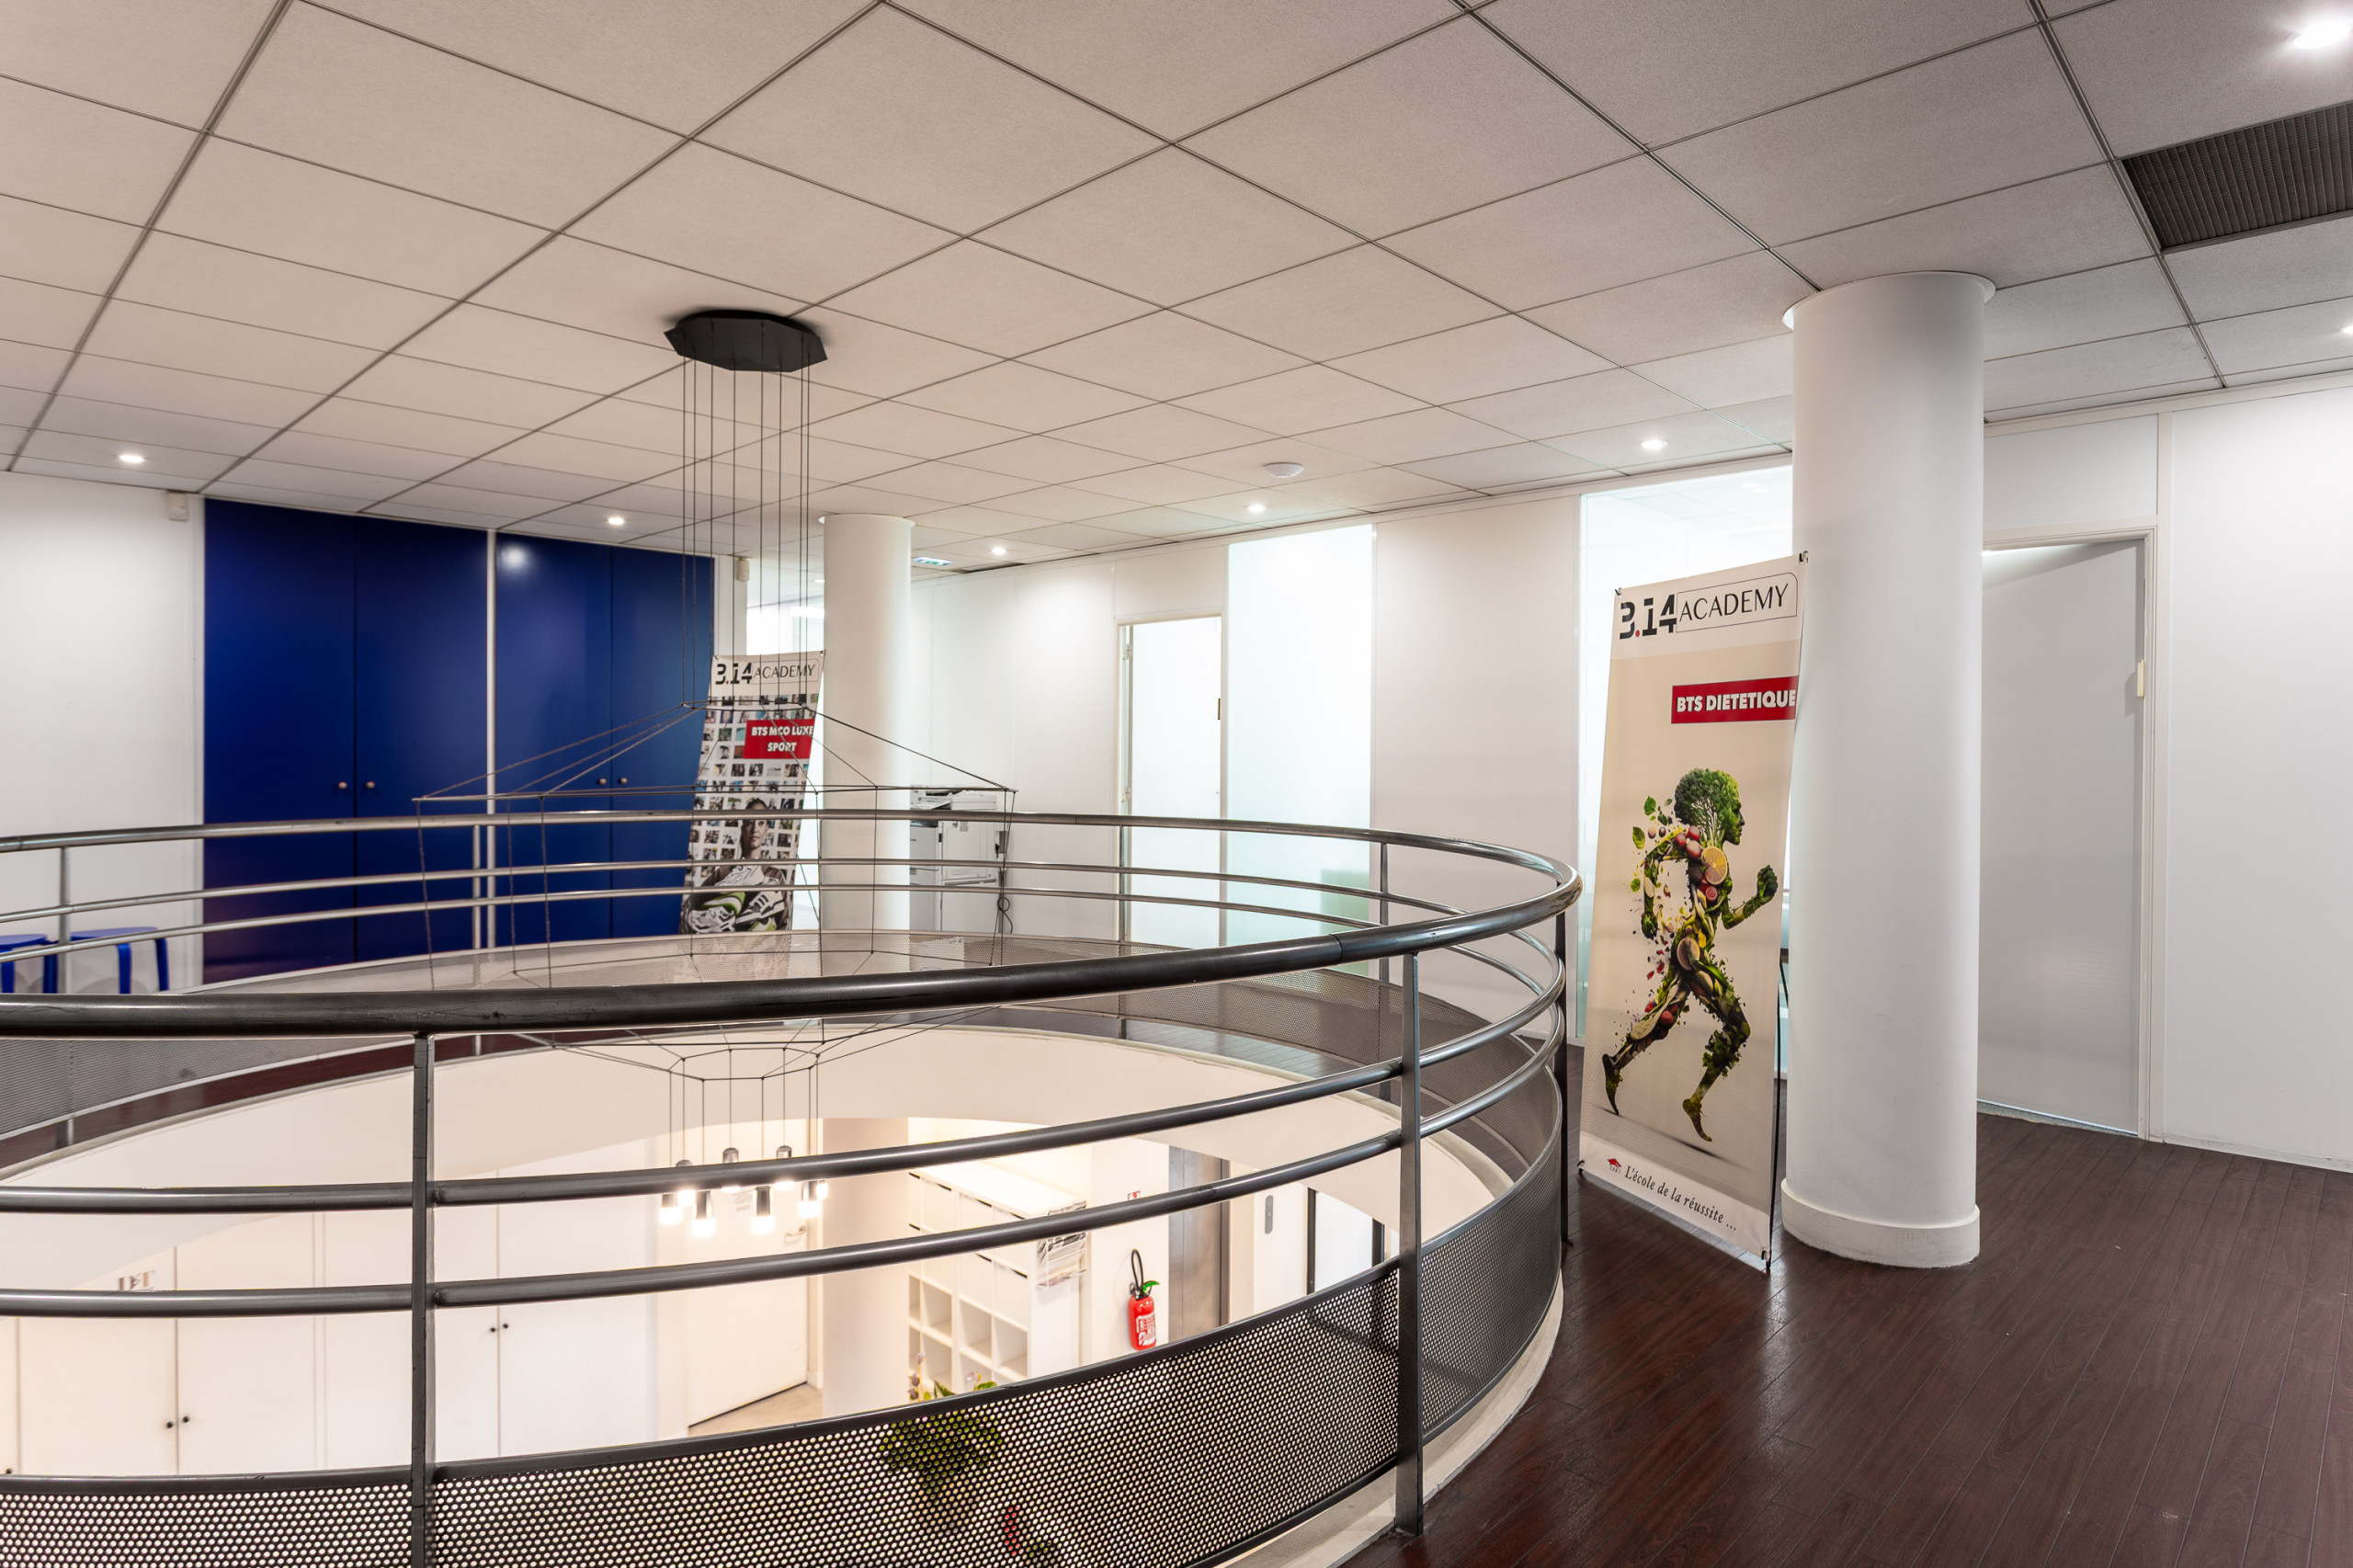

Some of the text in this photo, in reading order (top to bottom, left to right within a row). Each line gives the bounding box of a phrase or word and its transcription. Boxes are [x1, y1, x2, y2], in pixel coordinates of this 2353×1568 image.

[1619, 583, 1789, 640] 3.14 ACADEMY
[715, 663, 815, 685] 3.14 ACADEMY
[1677, 689, 1796, 712] BTS DIETETIQUE
[751, 725, 813, 736] BTS MCO LUXE
[767, 743, 797, 752] SPORT
[1657, 1182, 1669, 1197] de
[1670, 1187, 1682, 1202] la
[1683, 1197, 1724, 1223] réussite
